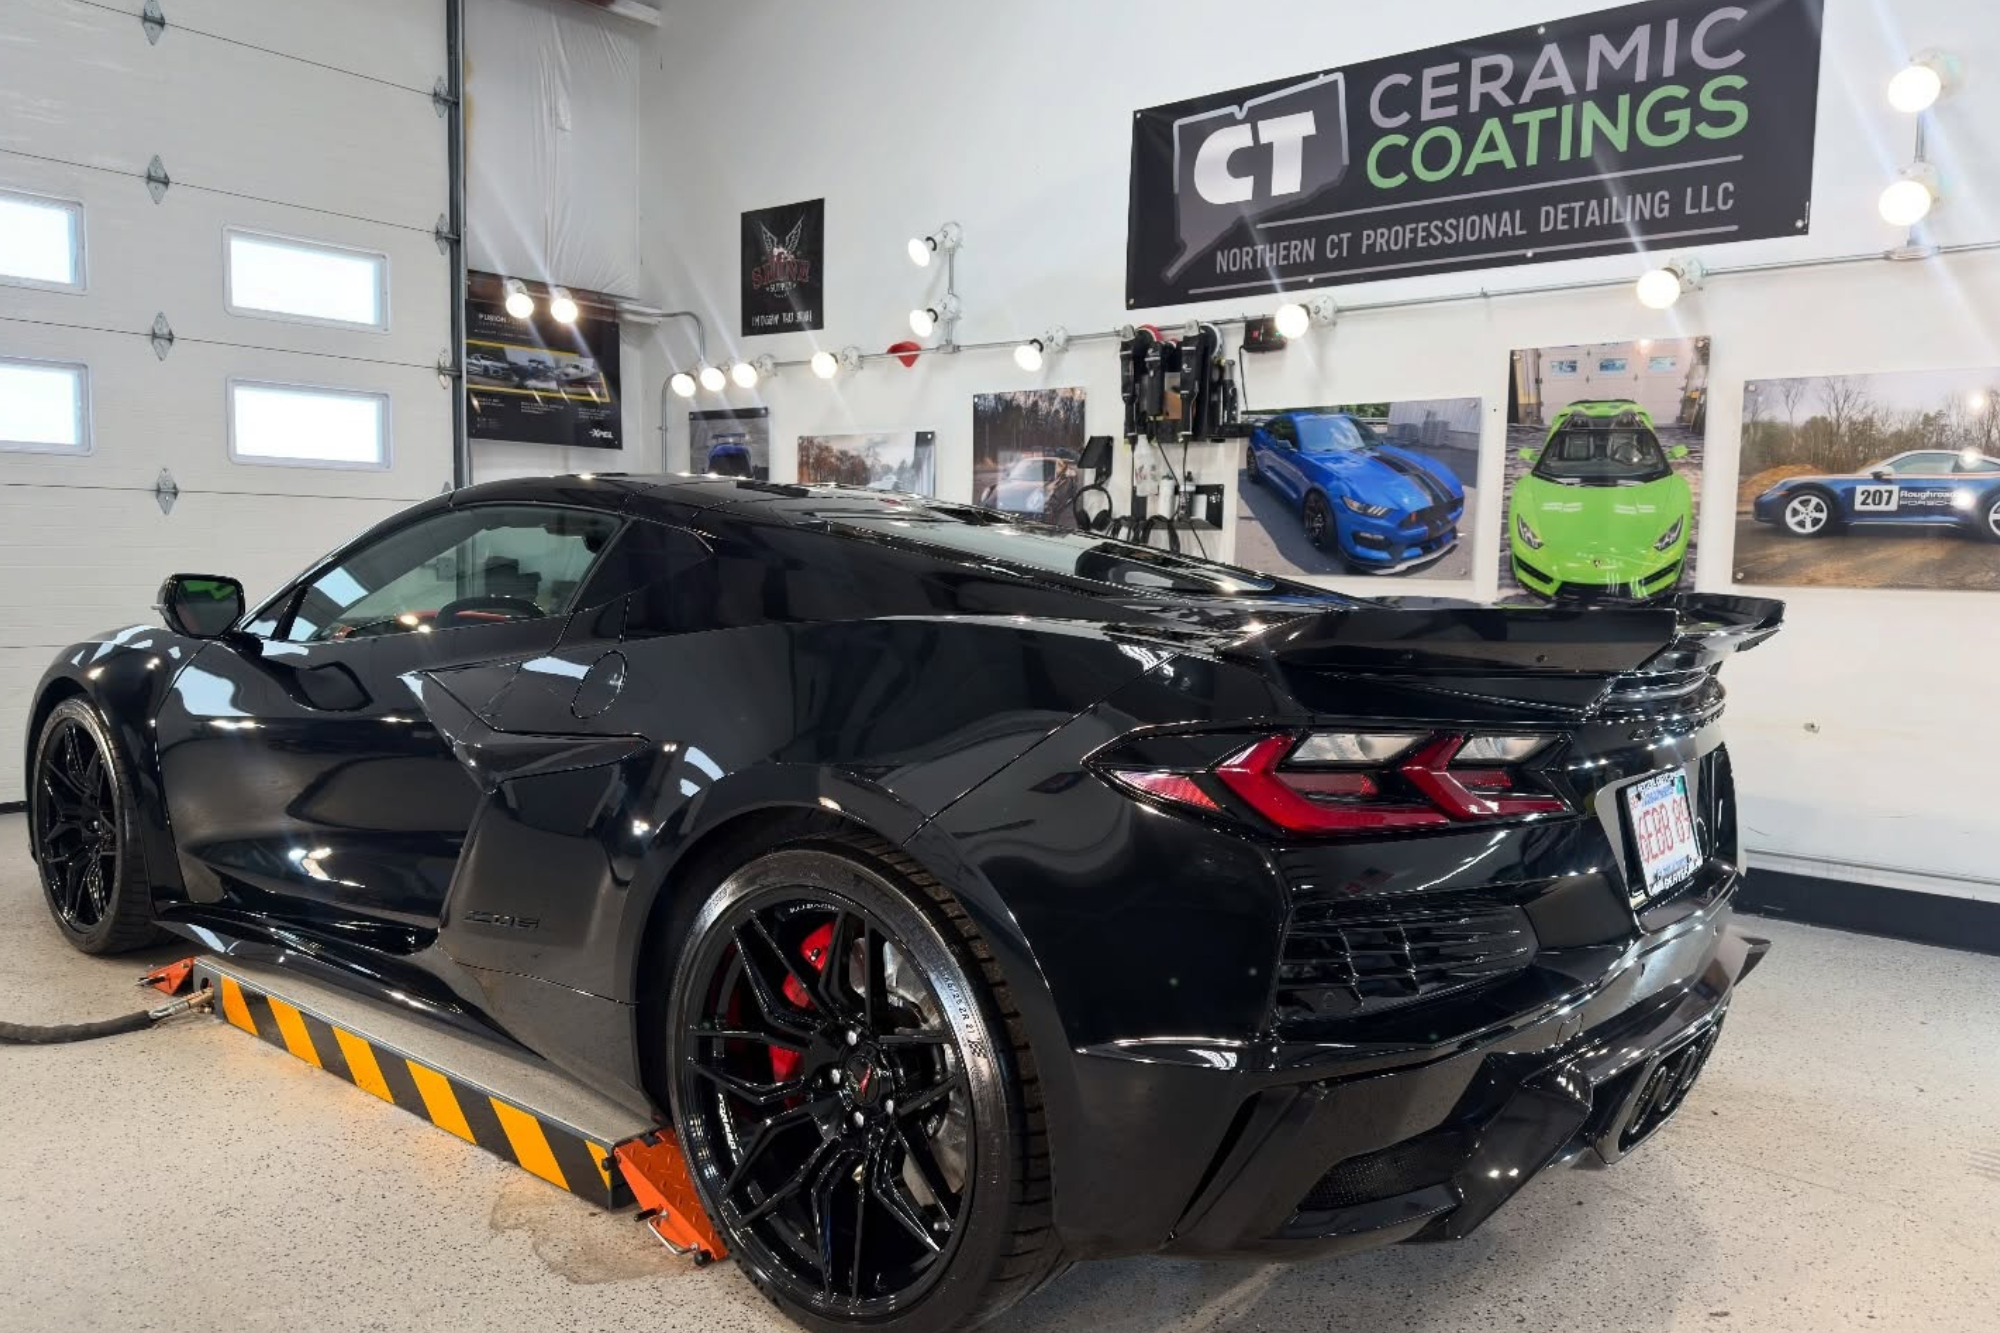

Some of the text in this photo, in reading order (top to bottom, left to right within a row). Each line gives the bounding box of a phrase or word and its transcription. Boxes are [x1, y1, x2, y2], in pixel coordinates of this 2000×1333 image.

[1369, 6, 1748, 129] CERAMIC
[1193, 112, 1317, 205] CT
[1366, 74, 1750, 190] COATINGS
[1215, 182, 1736, 274] NORTHERN CT PROFESSIONAL DETAILING LLC
[1860, 489, 1893, 506] 207
